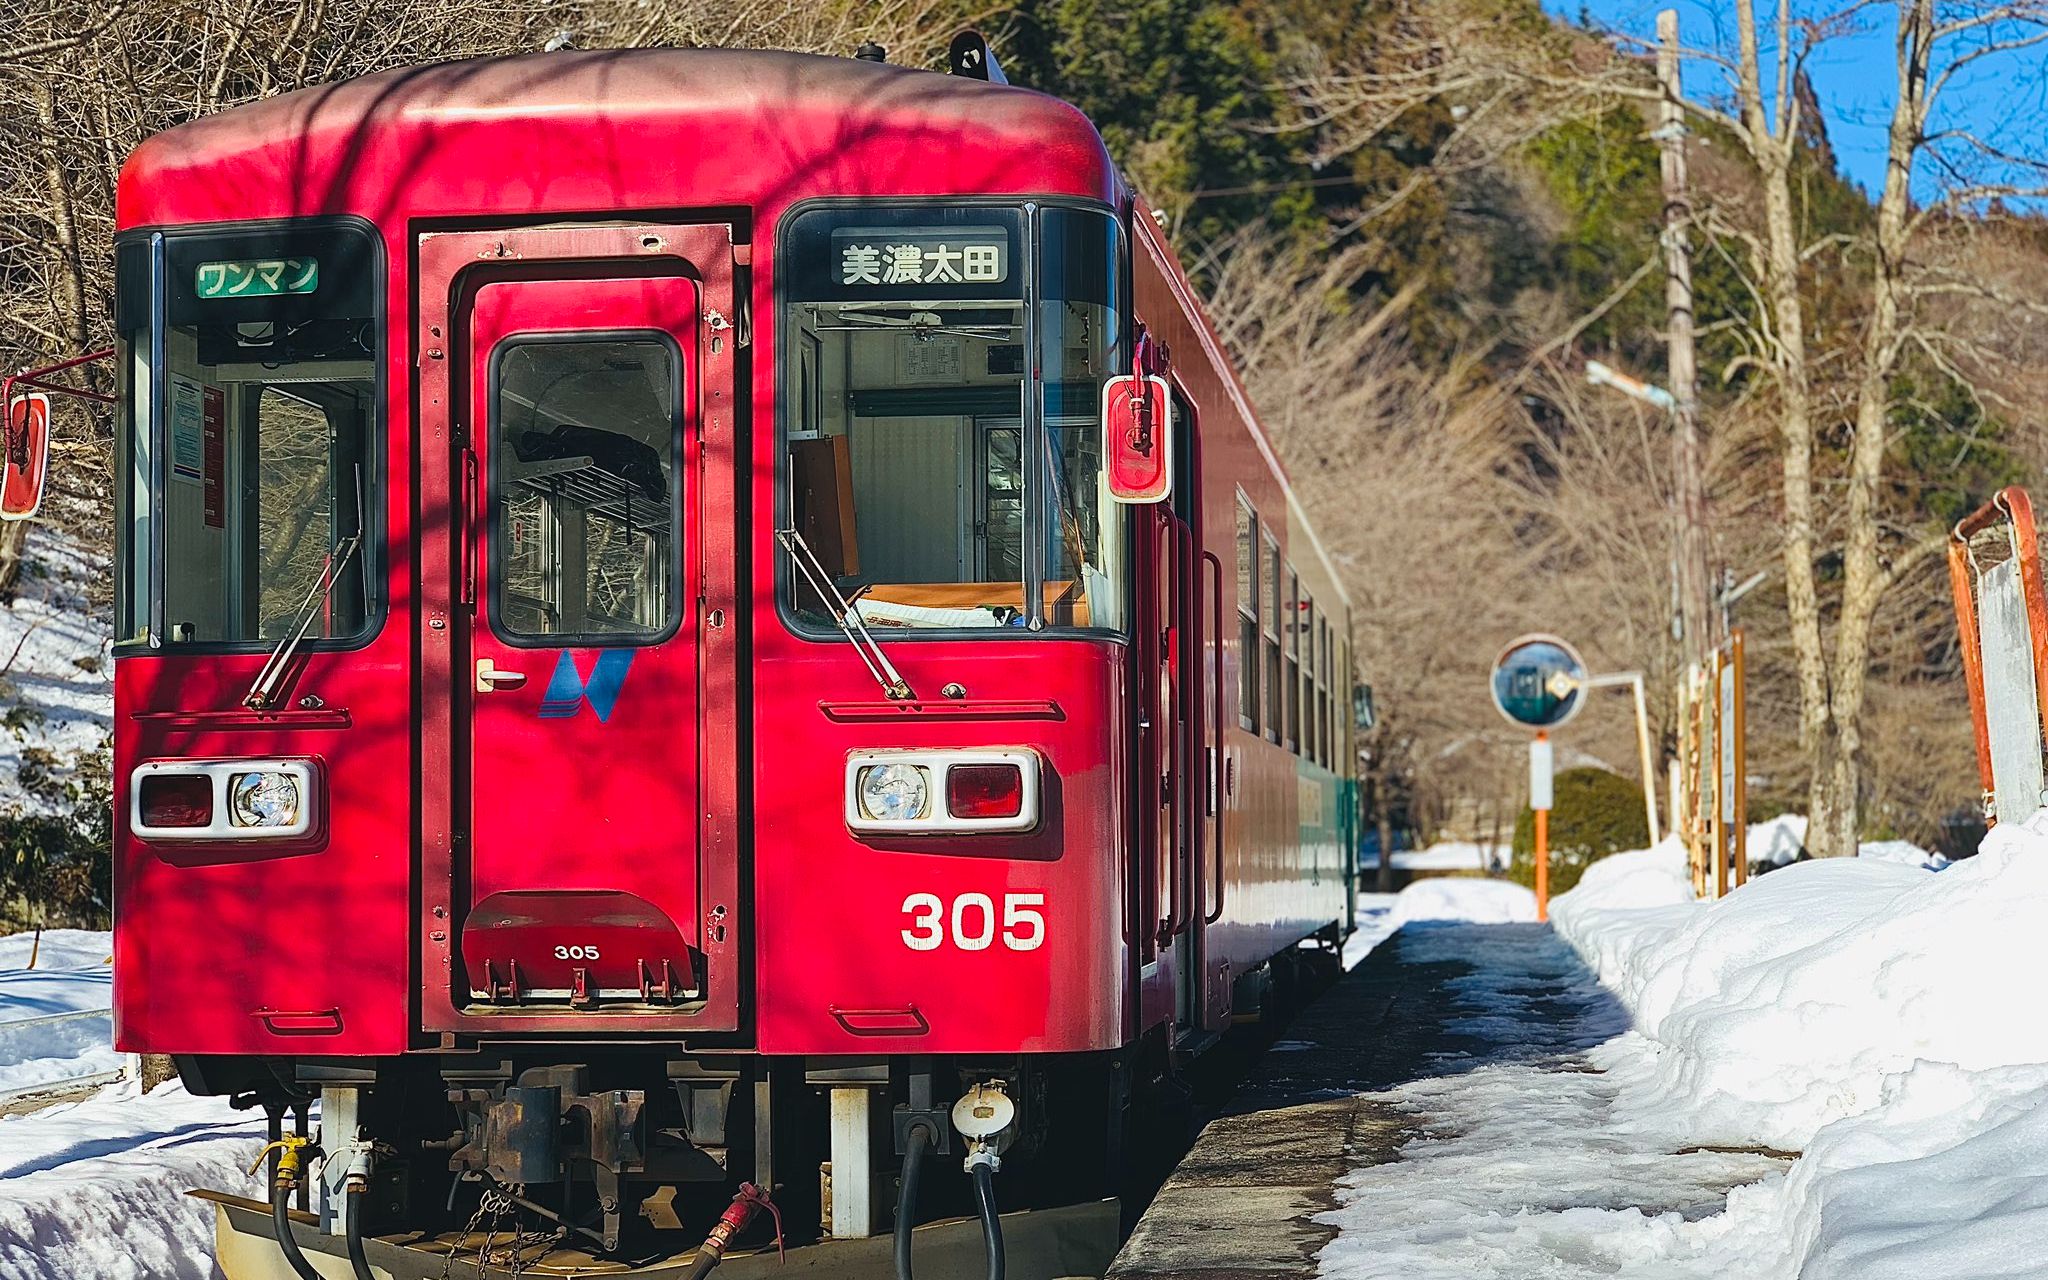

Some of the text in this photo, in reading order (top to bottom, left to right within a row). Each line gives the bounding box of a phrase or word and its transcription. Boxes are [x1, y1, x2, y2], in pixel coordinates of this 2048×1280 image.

[199, 260, 316, 295] ワンマン
[842, 244, 999, 285] 美濃太田
[901, 892, 1045, 951] 305
[554, 945, 600, 960] 305
